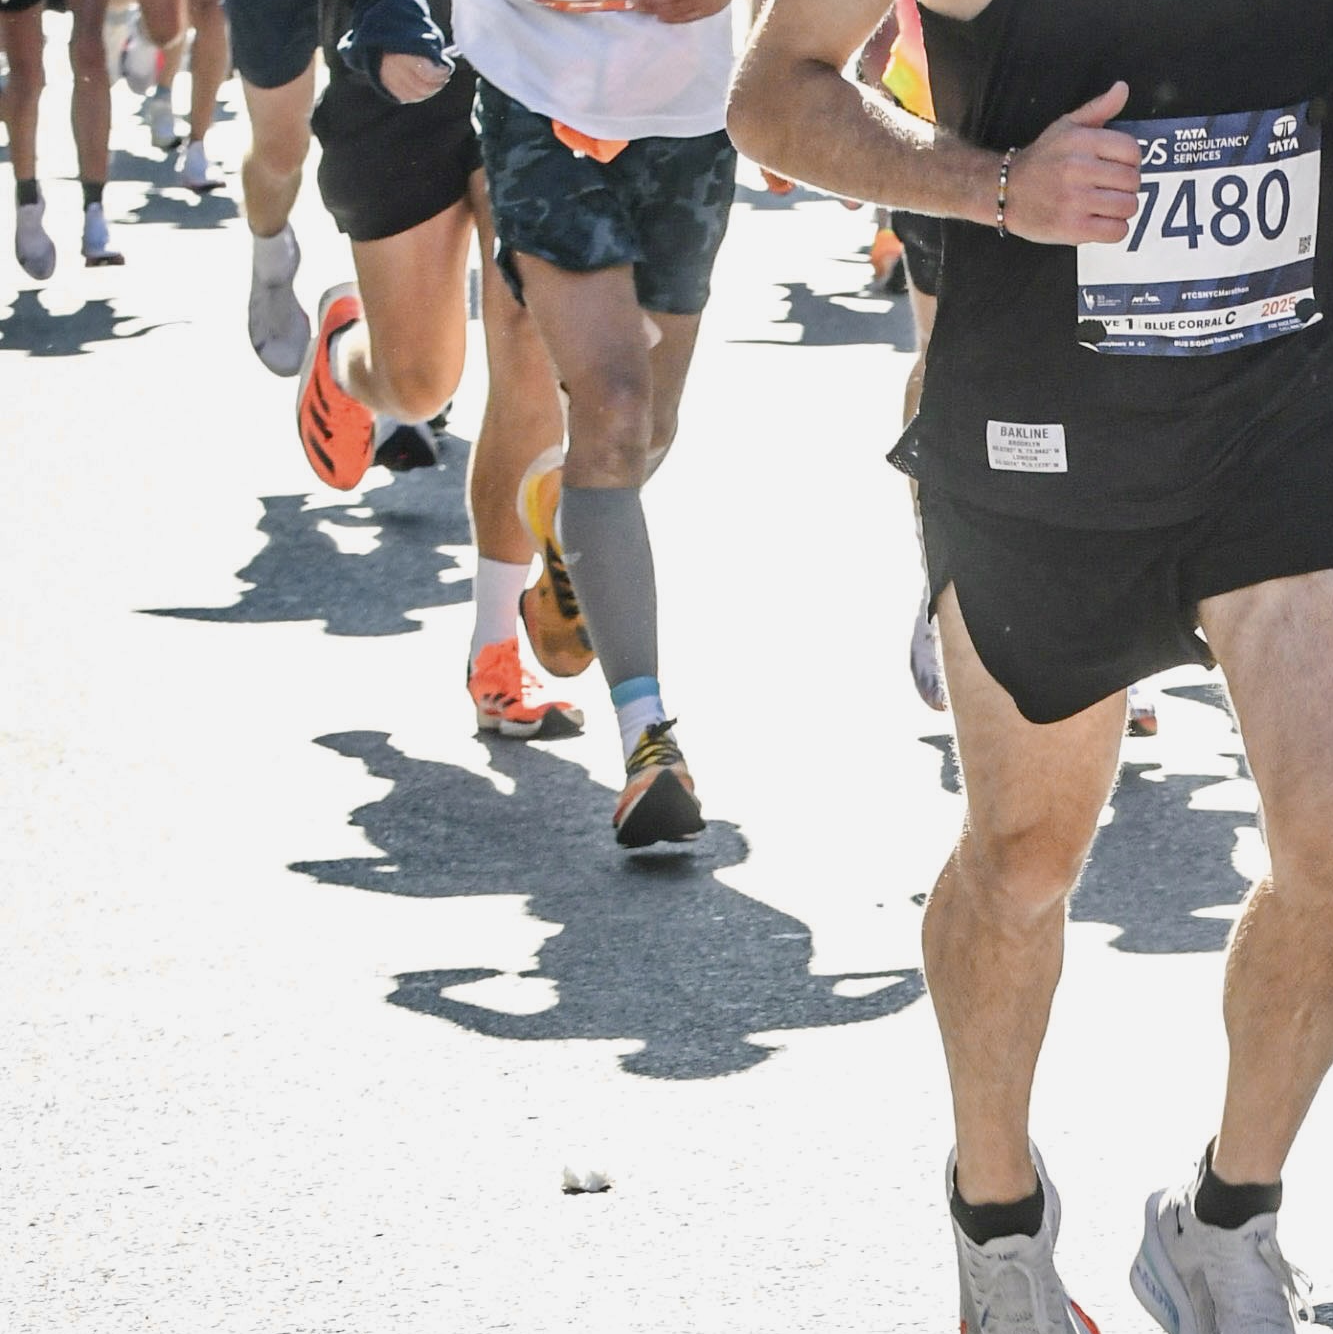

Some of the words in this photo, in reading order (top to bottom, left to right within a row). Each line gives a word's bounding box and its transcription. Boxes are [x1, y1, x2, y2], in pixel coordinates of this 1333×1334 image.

[1174, 127, 1208, 140] TATA
[1173, 135, 1250, 152] CONSULTANCY
[1267, 136, 1300, 155] TATA
[1173, 150, 1221, 165] SERVICES
[1127, 168, 1291, 253] 7480
[1125, 317, 1135, 330] 1
[1144, 319, 1177, 331] BLUE
[1177, 317, 1224, 330] CORRAL
[1224, 310, 1238, 326] C
[1260, 296, 1298, 318] 2025
[1000, 426, 1049, 439] BAKLINE
